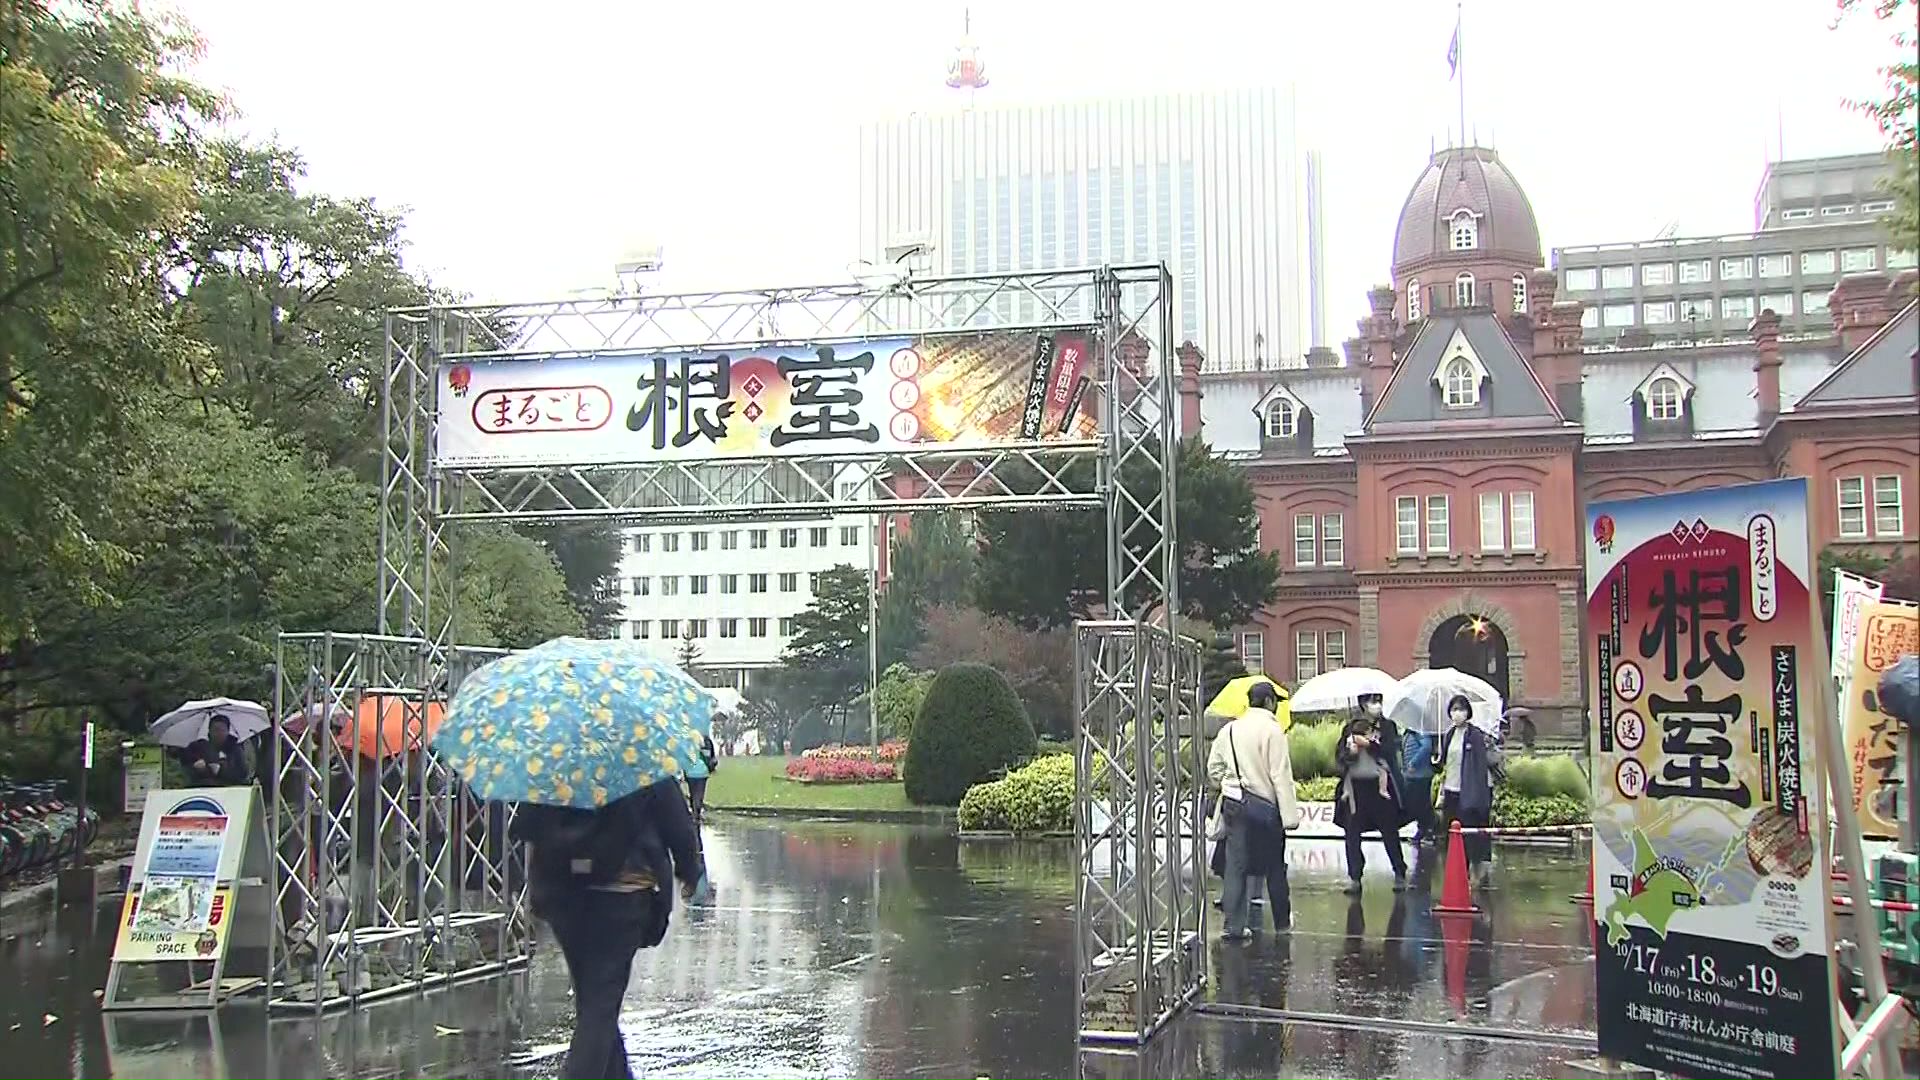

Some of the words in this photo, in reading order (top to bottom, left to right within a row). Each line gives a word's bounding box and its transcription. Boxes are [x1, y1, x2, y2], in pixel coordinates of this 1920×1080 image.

[491, 391, 593, 428] まるごと
[626, 346, 881, 450] 根室
[1023, 338, 1051, 437] さんま炭火焼き
[1754, 522, 1771, 615] まるごと
[1639, 565, 1752, 809] 根室
[1775, 650, 1799, 812] さんま炭火焼き
[130, 932, 173, 942] PARKING
[156, 943, 187, 954] SPACE
[1626, 1002, 1797, 1055] 北海道庁赤れんが庁舎前庭
